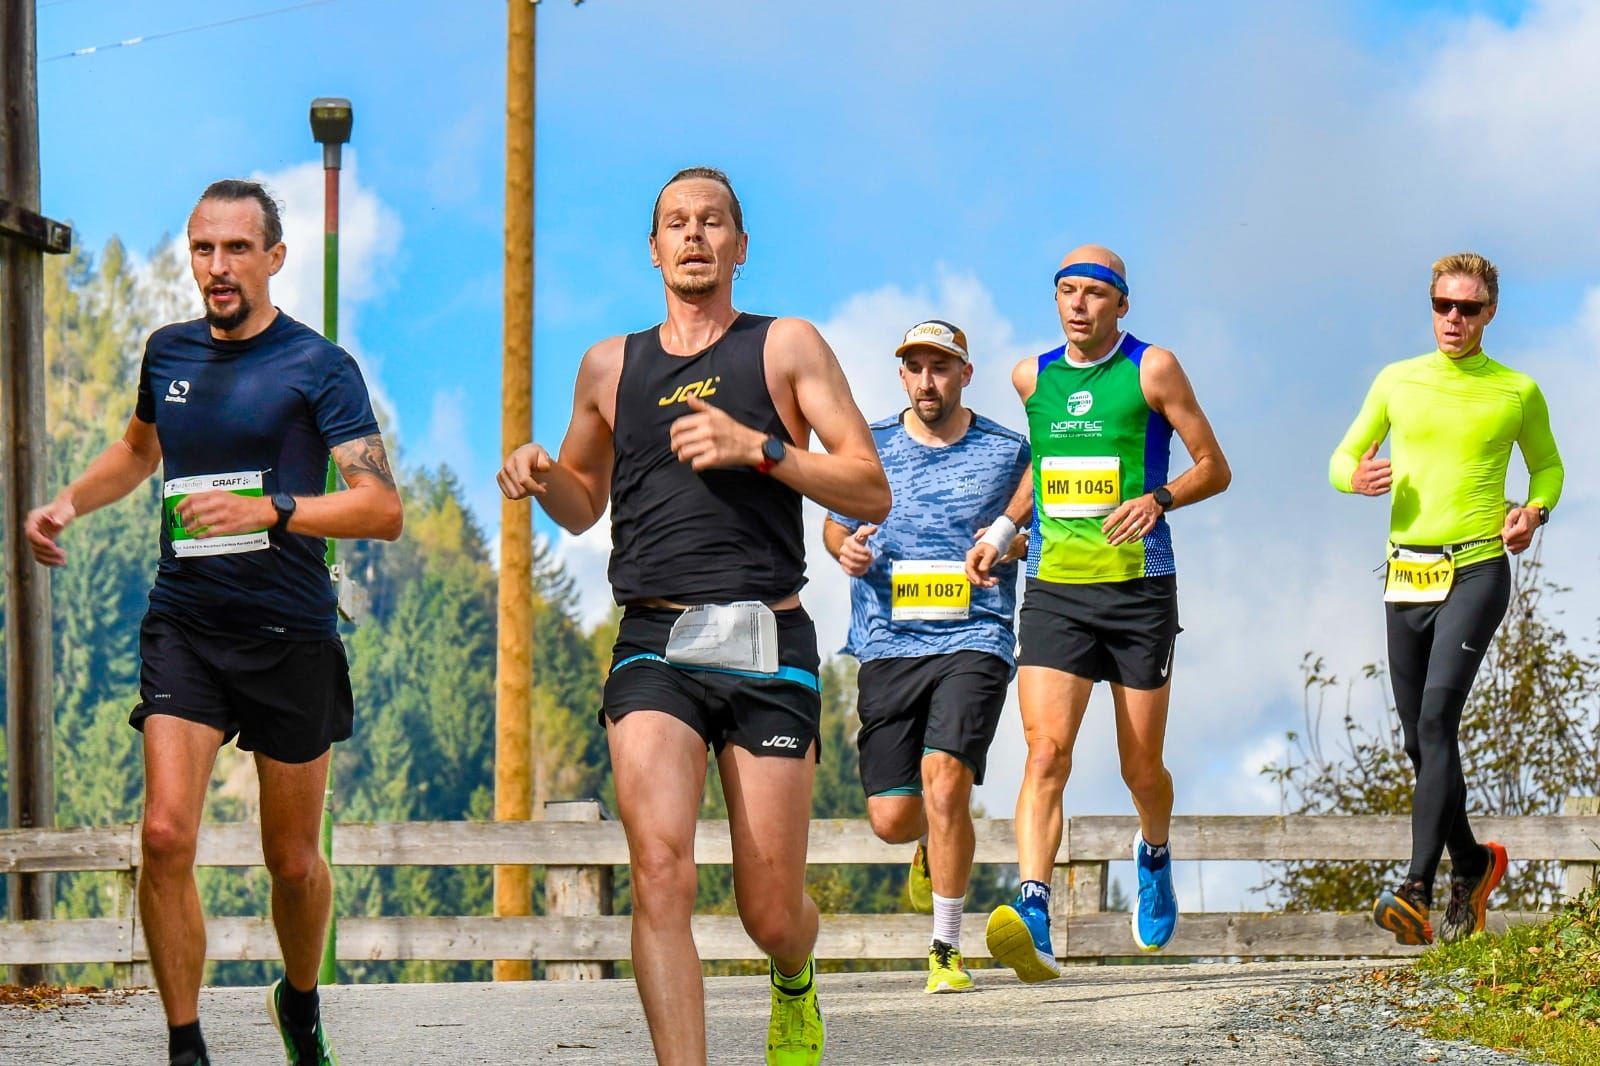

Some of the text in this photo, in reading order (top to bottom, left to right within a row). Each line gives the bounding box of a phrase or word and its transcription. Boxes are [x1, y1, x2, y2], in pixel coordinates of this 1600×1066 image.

[1051, 420, 1103, 430] NORTEC
[212, 477, 242, 488] CRAFT
[1047, 480, 1114, 494] HM 1045
[1394, 569, 1450, 584] HM 1117
[897, 583, 964, 598] HM 1087
[761, 735, 799, 749] JOL
